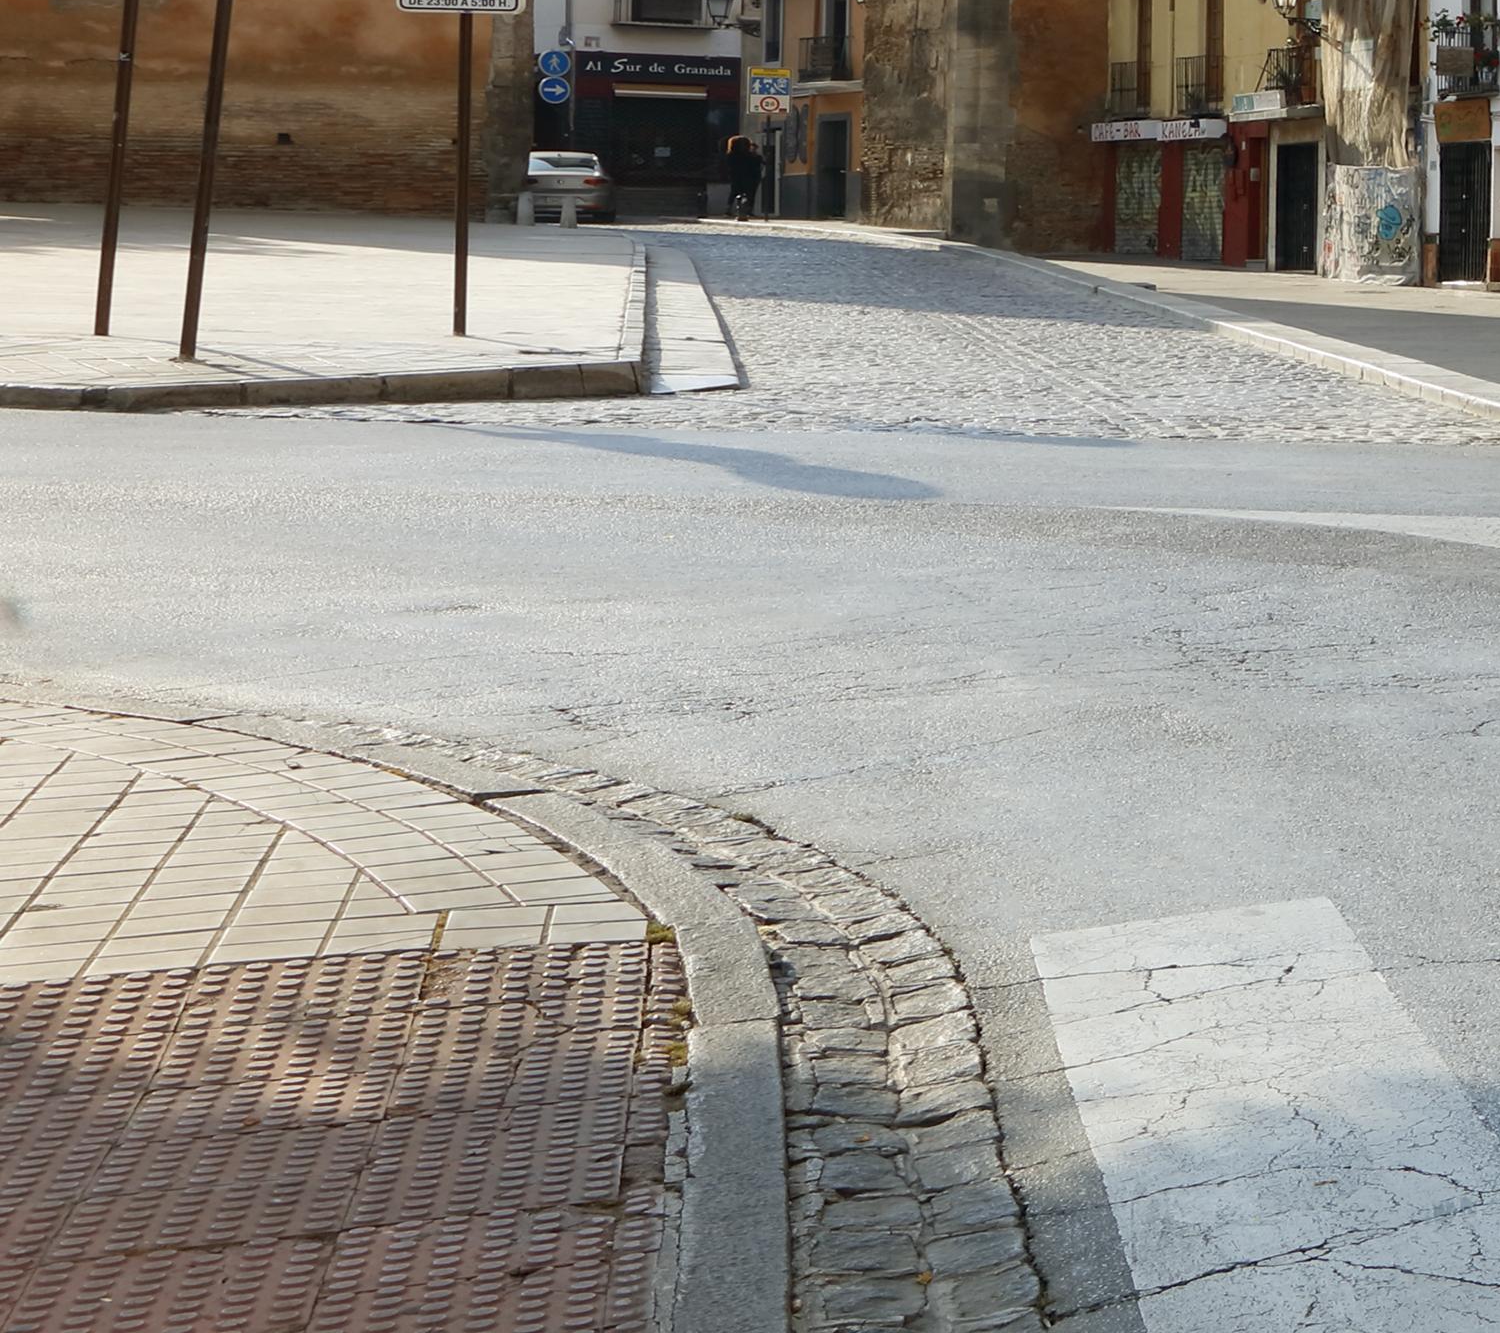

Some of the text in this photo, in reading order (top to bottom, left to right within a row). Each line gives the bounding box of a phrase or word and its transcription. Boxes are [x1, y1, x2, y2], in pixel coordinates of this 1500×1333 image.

[498, 0, 511, 8] H.
[585, 58, 732, 76] Al Sur de Granada
